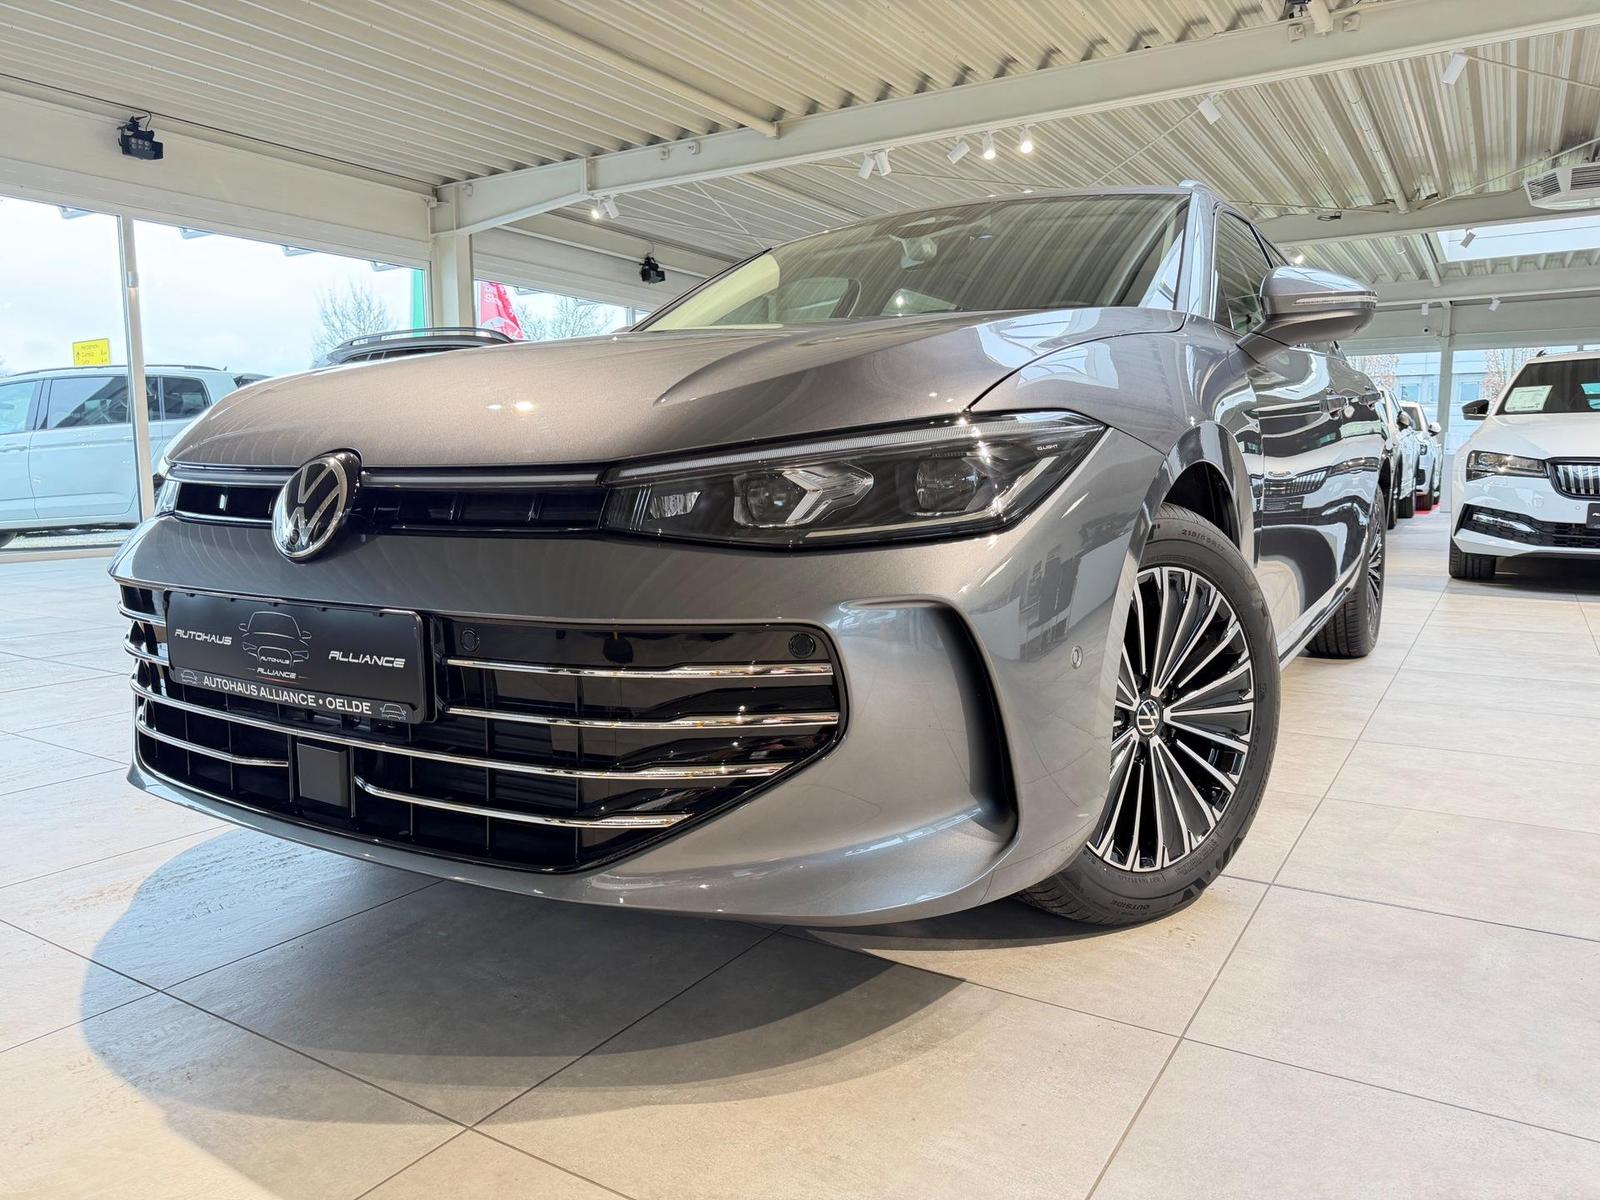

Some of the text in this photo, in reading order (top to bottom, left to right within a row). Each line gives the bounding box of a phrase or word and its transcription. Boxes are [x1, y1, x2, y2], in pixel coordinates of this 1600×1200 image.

[174, 629, 233, 645] AUTOHAUS
[260, 655, 291, 665] AUTOHAUS
[328, 650, 406, 669] ALLIANCE
[256, 667, 297, 679] ALLIANCE
[203, 675, 373, 715] AUTOHAUS ALLIANCE OELDE
